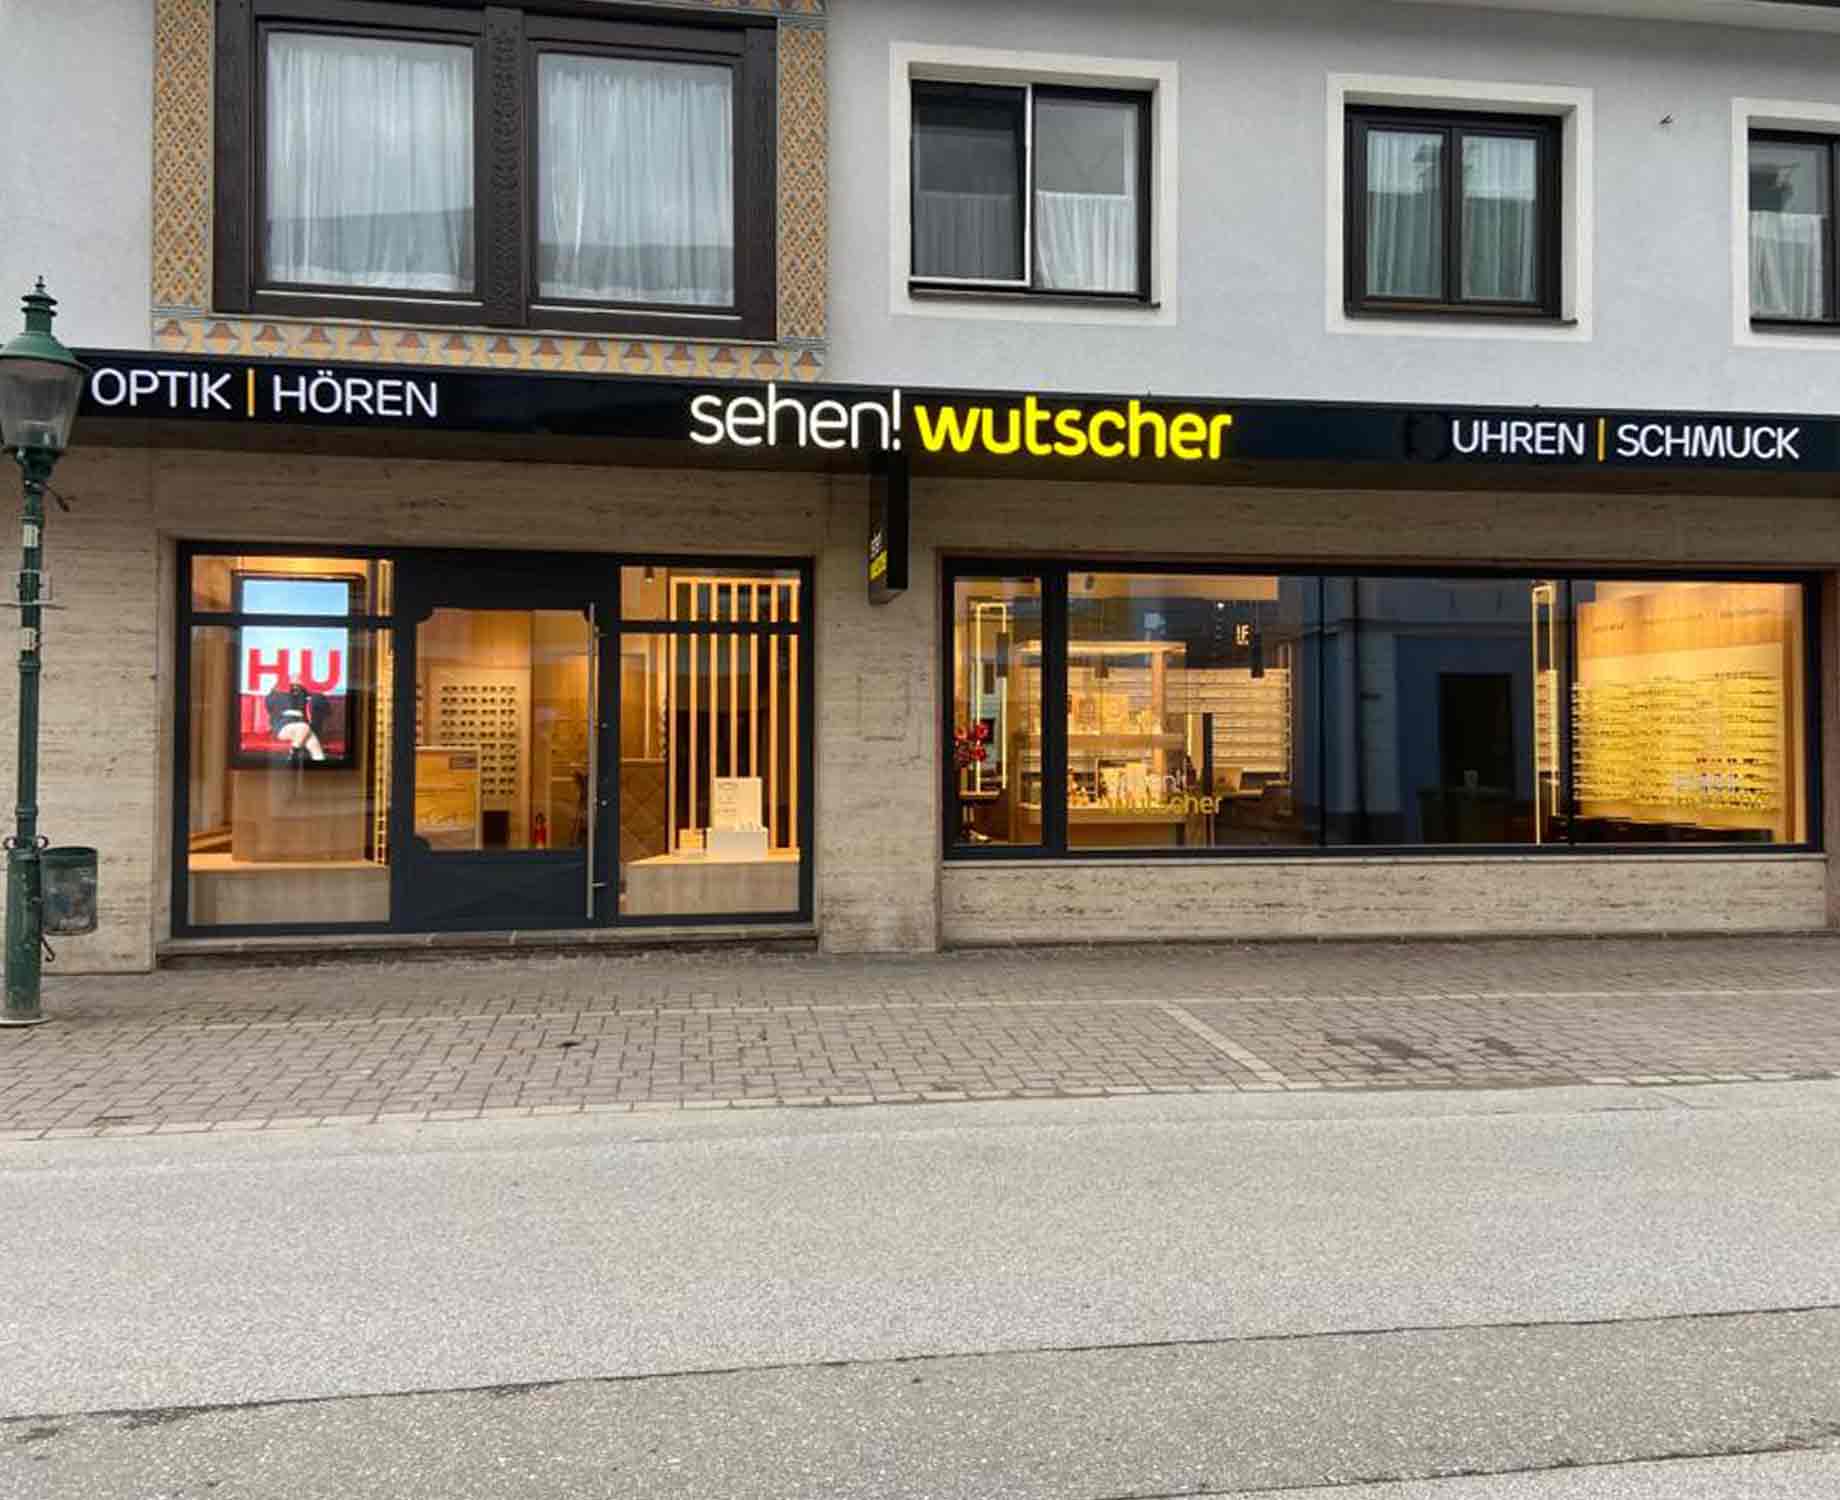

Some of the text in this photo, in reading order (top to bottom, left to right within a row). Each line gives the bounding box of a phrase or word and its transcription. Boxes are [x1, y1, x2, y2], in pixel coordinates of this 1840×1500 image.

[91, 368, 438, 418] OPTIK HÖREN
[689, 383, 1233, 459] sehen! wutscher
[1452, 419, 1800, 459] UHREN SCHMUCK
